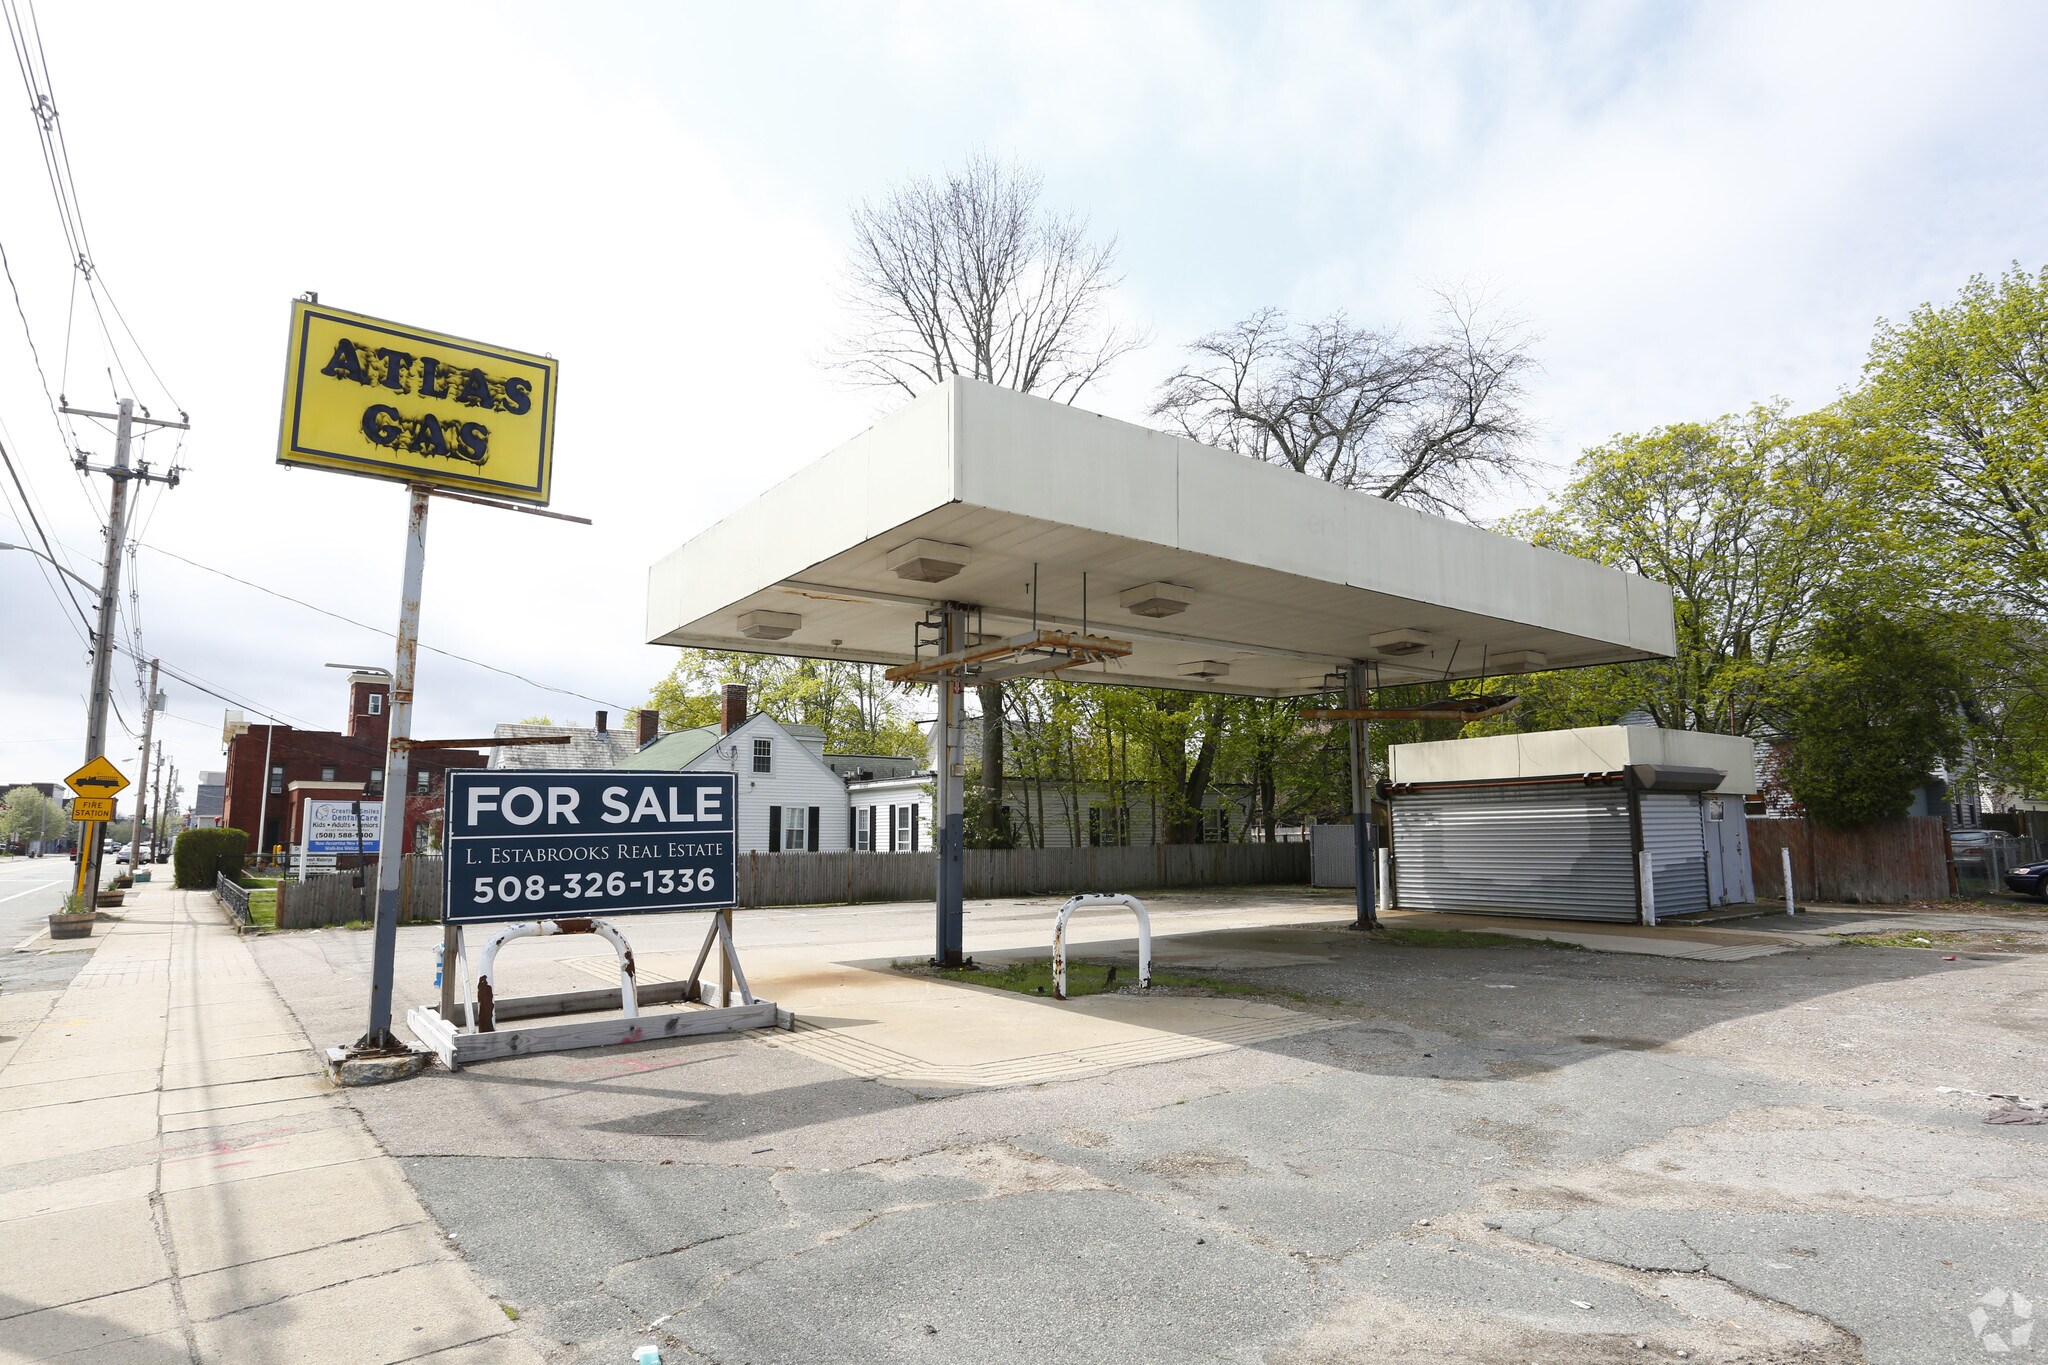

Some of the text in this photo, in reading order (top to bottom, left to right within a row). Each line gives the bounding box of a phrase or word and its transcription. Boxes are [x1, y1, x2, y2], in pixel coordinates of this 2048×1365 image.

[320, 338, 532, 415] ATLAS
[361, 404, 489, 463] GAS
[467, 786, 723, 826] FOR SALE
[466, 841, 724, 865] L. ESTABROOKS REAL ESTATE
[473, 867, 716, 904] 508-326-1336
